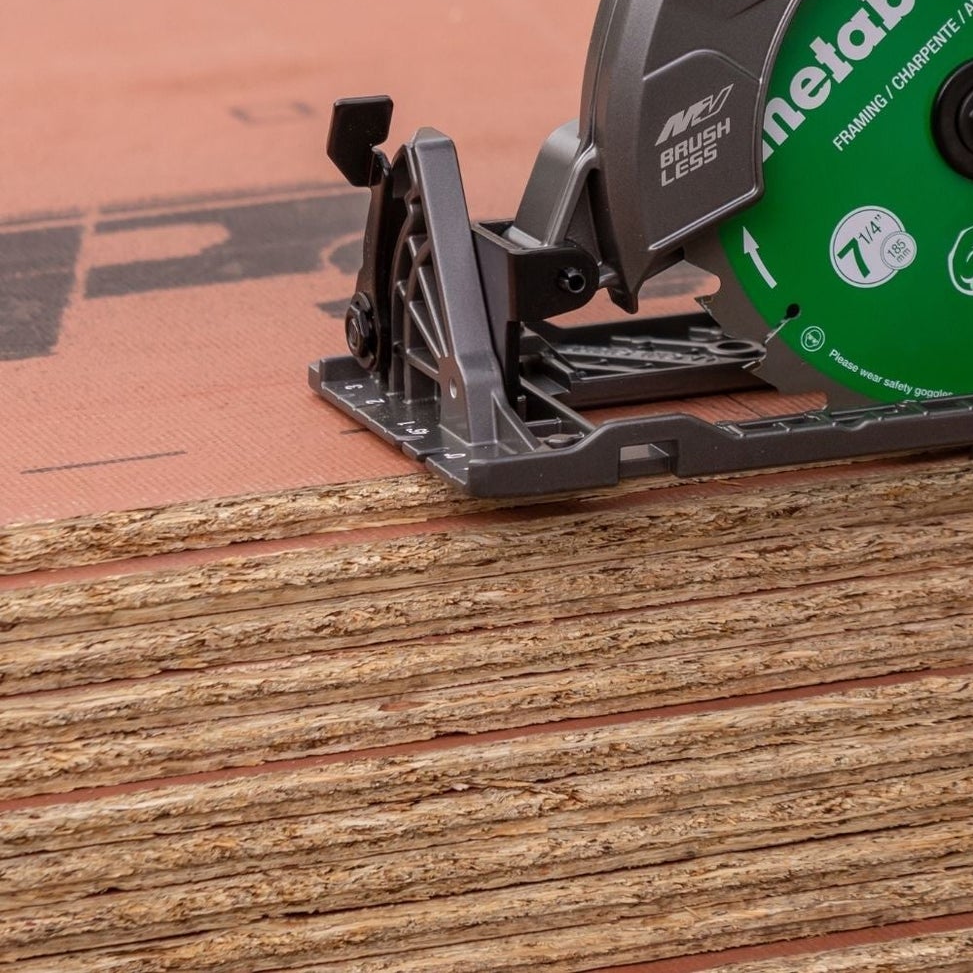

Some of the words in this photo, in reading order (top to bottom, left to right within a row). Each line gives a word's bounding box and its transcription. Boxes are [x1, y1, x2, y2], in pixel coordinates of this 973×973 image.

[832, 94, 888, 151] FRAMING
[892, 18, 960, 90] CHARPENTE
[660, 117, 731, 169] BRUSH
[661, 143, 718, 187] LESS
[837, 237, 871, 278] 7
[887, 239, 907, 260] 185
[829, 349, 859, 373] Please
[860, 368, 882, 383] wear
[883, 378, 913, 395] safety
